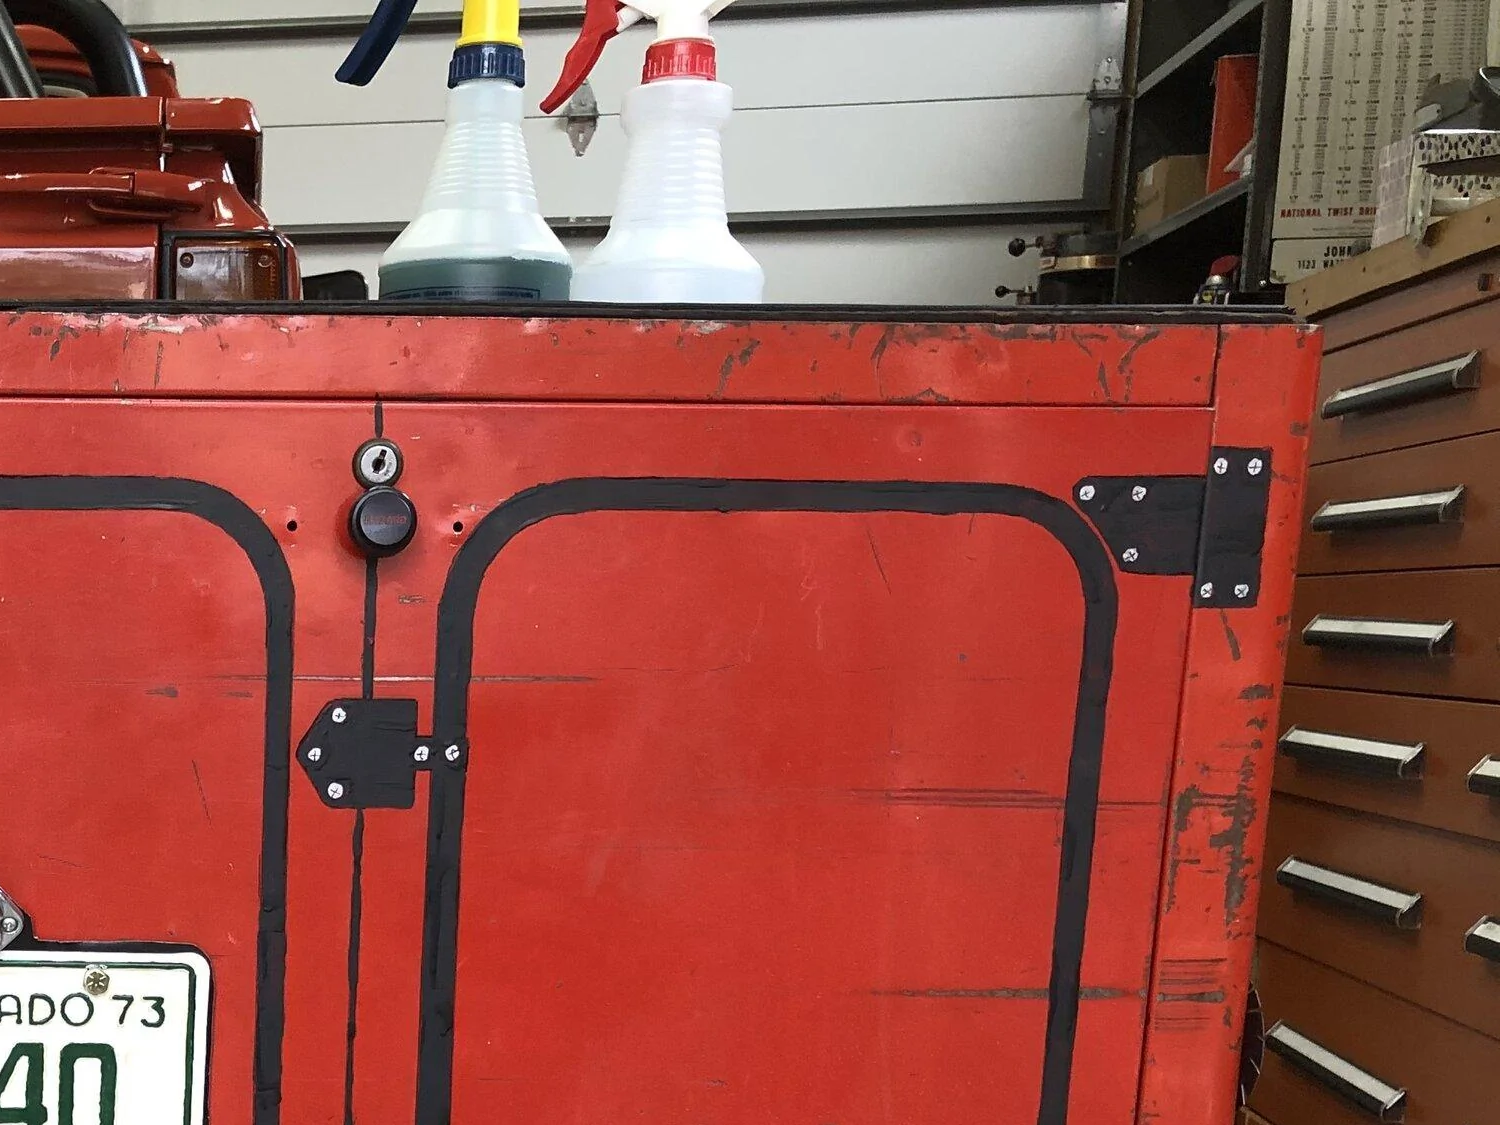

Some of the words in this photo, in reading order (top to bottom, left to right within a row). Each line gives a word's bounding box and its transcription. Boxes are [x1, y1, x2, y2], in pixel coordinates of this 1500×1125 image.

[1280, 208, 1321, 218] NATIONAL
[1327, 207, 1353, 217] TWIST
[112, 996, 166, 1028] 73
